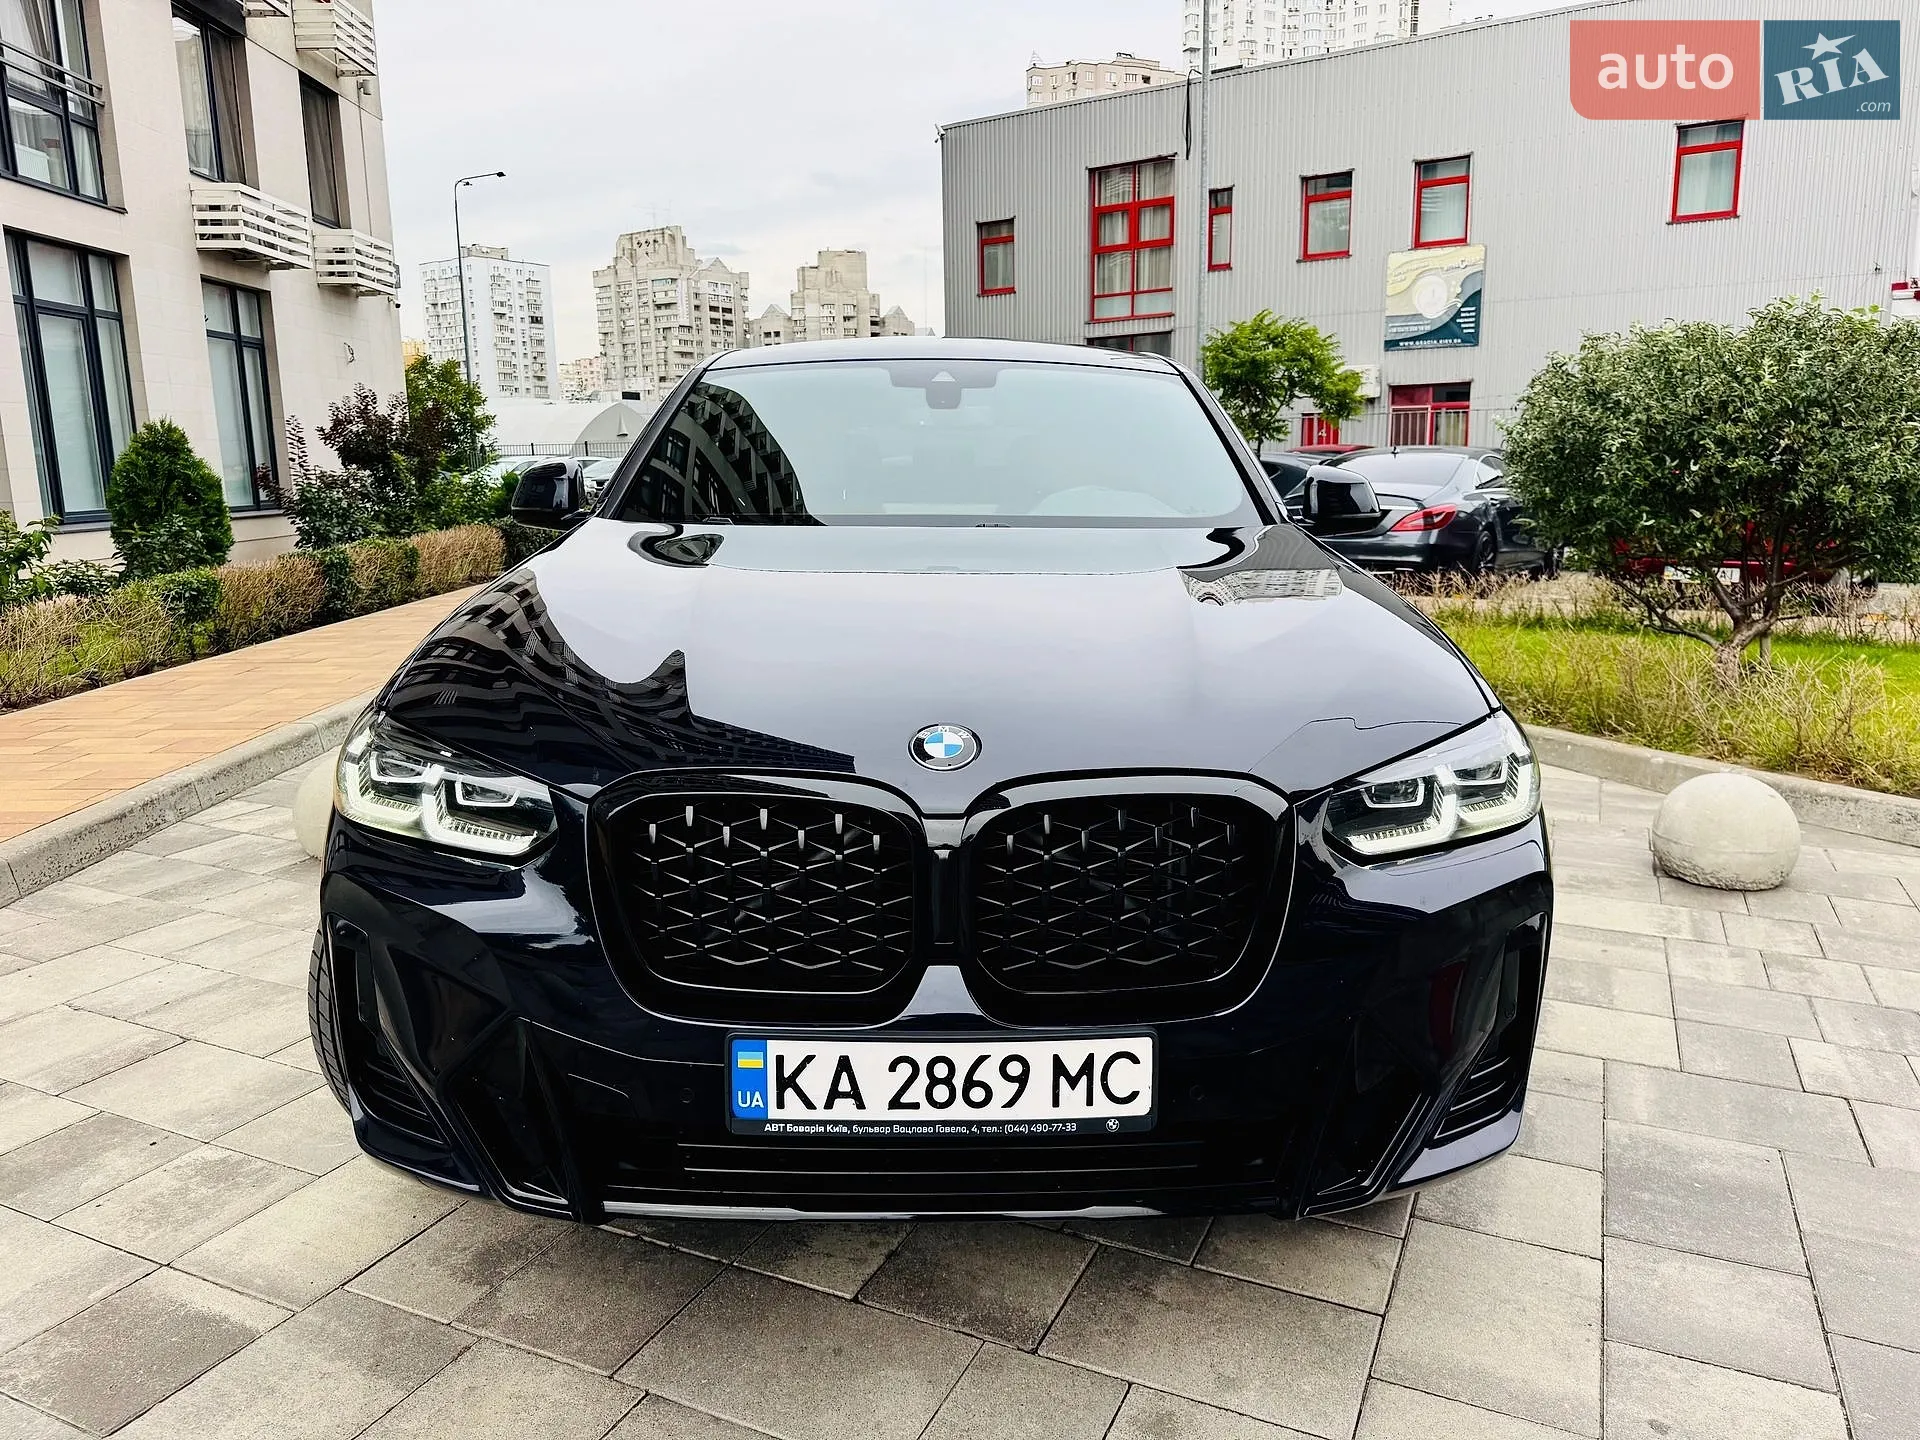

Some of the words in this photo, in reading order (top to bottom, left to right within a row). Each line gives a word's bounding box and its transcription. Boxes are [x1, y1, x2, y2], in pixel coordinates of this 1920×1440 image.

[775, 1054, 866, 1110] KA
[887, 1053, 1031, 1110] 2869
[1052, 1050, 1141, 1108] MC
[737, 1090, 765, 1108] UA
[764, 1123, 785, 1132] АВТ
[786, 1123, 825, 1134] Баварія
[826, 1123, 851, 1134] Київ,
[852, 1124, 891, 1134] бульвар
[892, 1124, 934, 1135] Вацлава
[935, 1124, 970, 1135] Гавела,
[971, 1124, 980, 1135] 4,
[981, 1124, 1002, 1133] тел.:
[1004, 1123, 1029, 1134] (044)
[1030, 1122, 1077, 1133] 490-77-33
